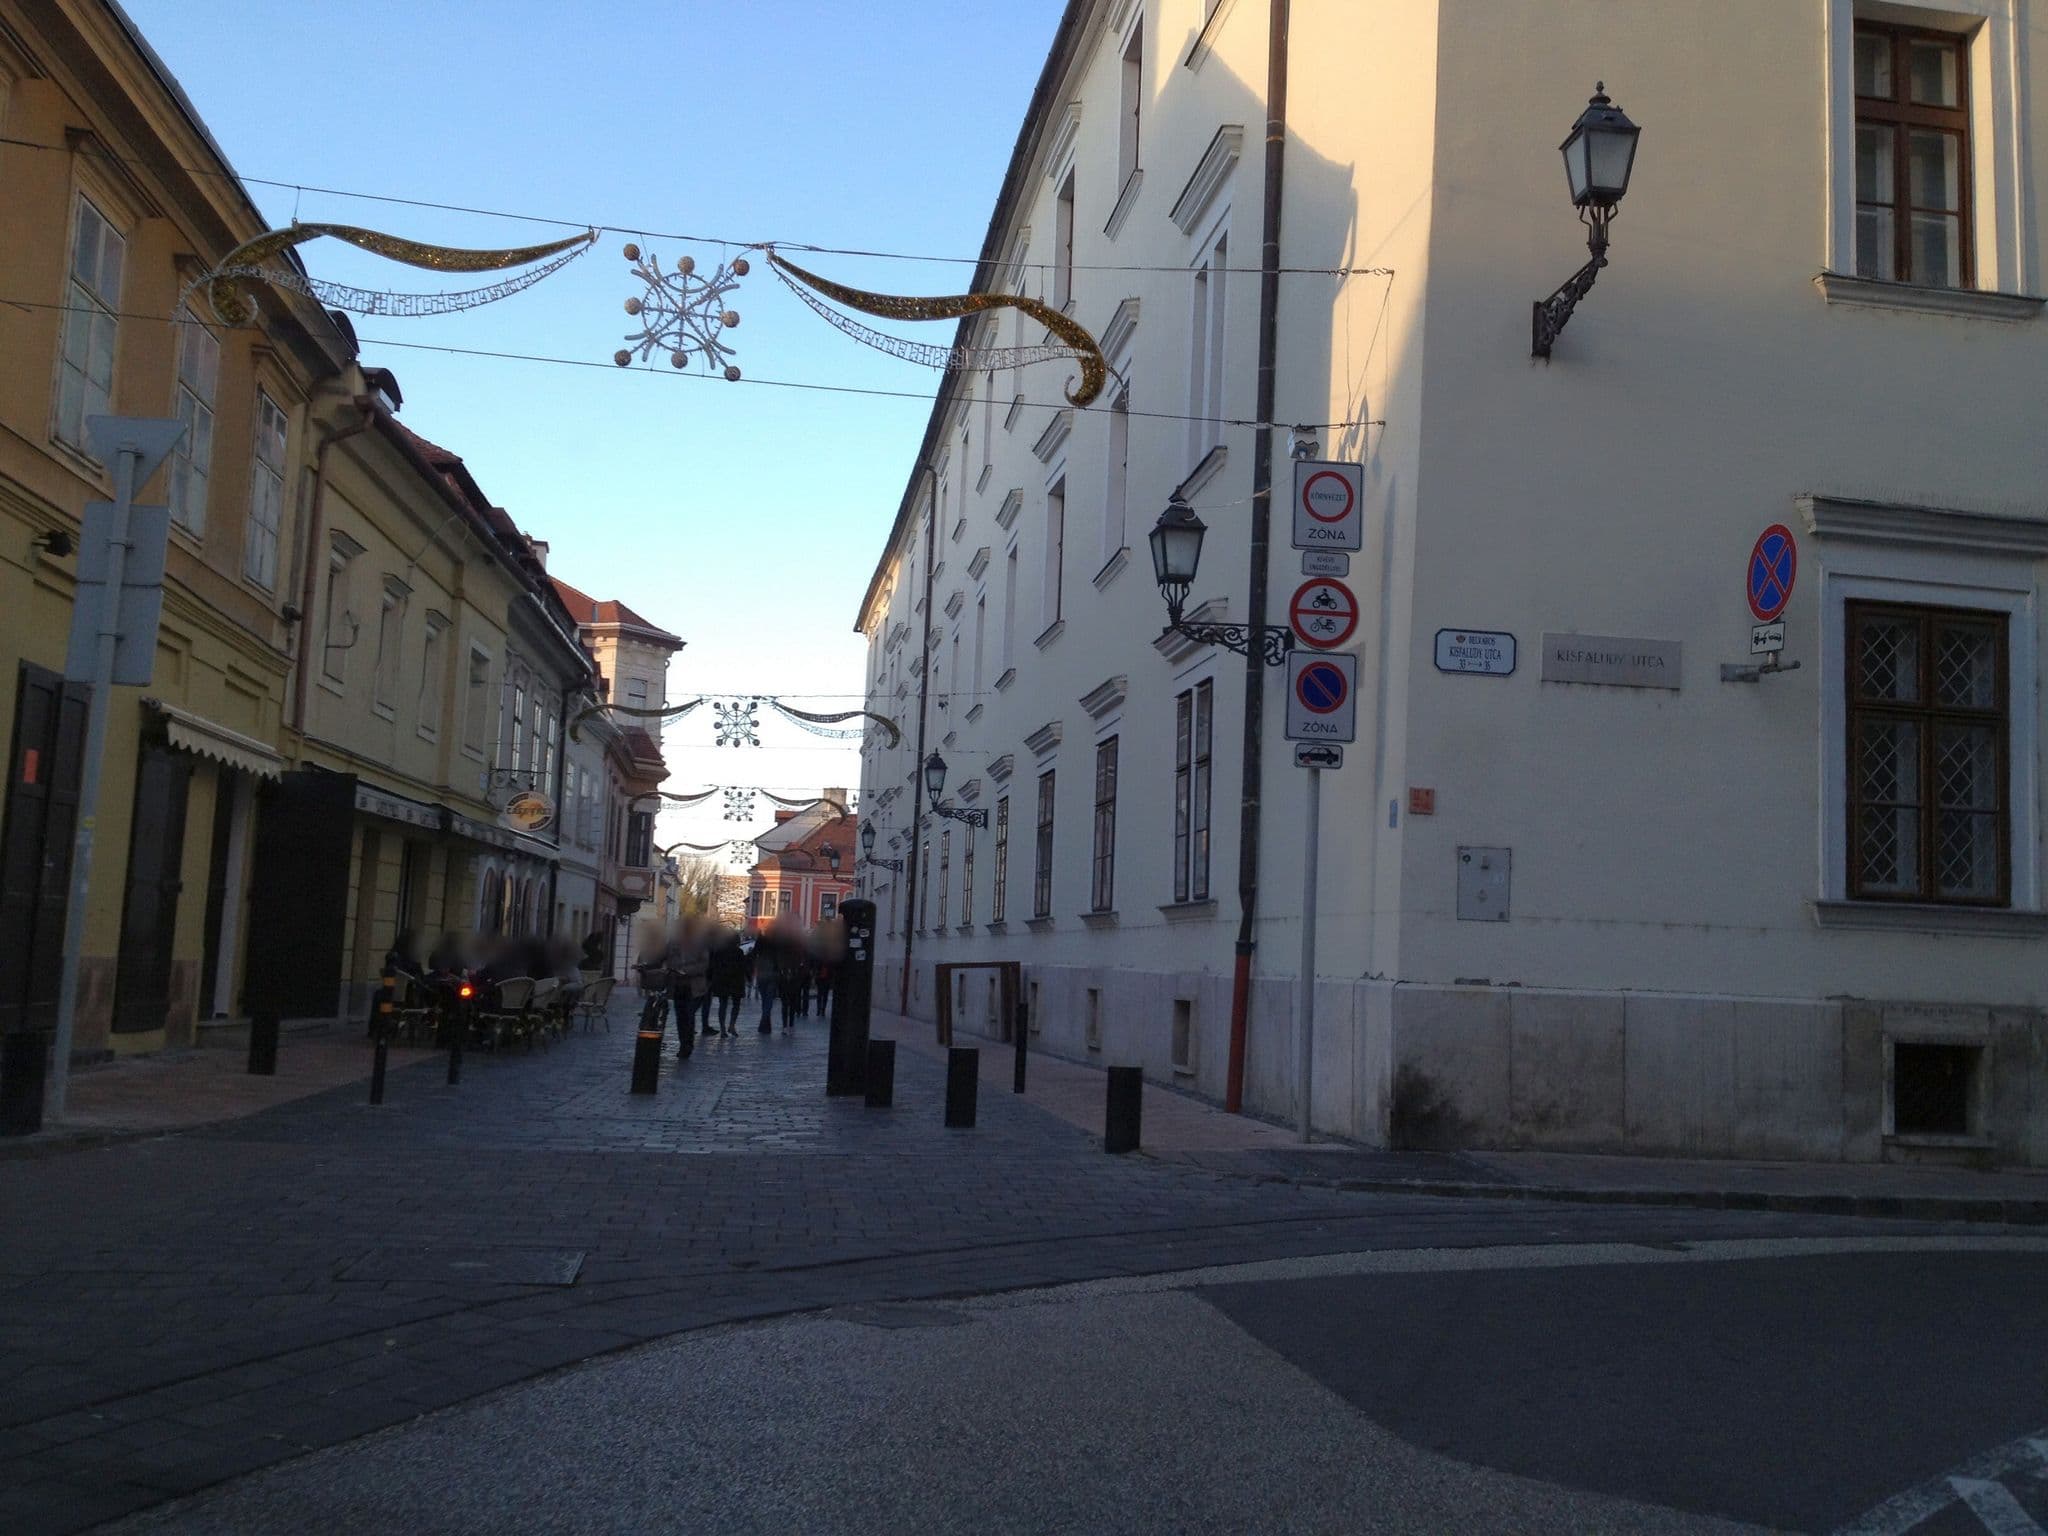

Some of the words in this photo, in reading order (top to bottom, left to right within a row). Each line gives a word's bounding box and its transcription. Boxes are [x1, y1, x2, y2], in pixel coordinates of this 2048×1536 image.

[1308, 527, 1346, 541] ZÓNA
[1449, 646, 1482, 659] KISFALUDY
[1484, 648, 1502, 661] UTCA
[1556, 649, 1624, 665] KISFALUDY
[1632, 655, 1665, 668] UTCA
[1302, 721, 1338, 734] ZÓNA
